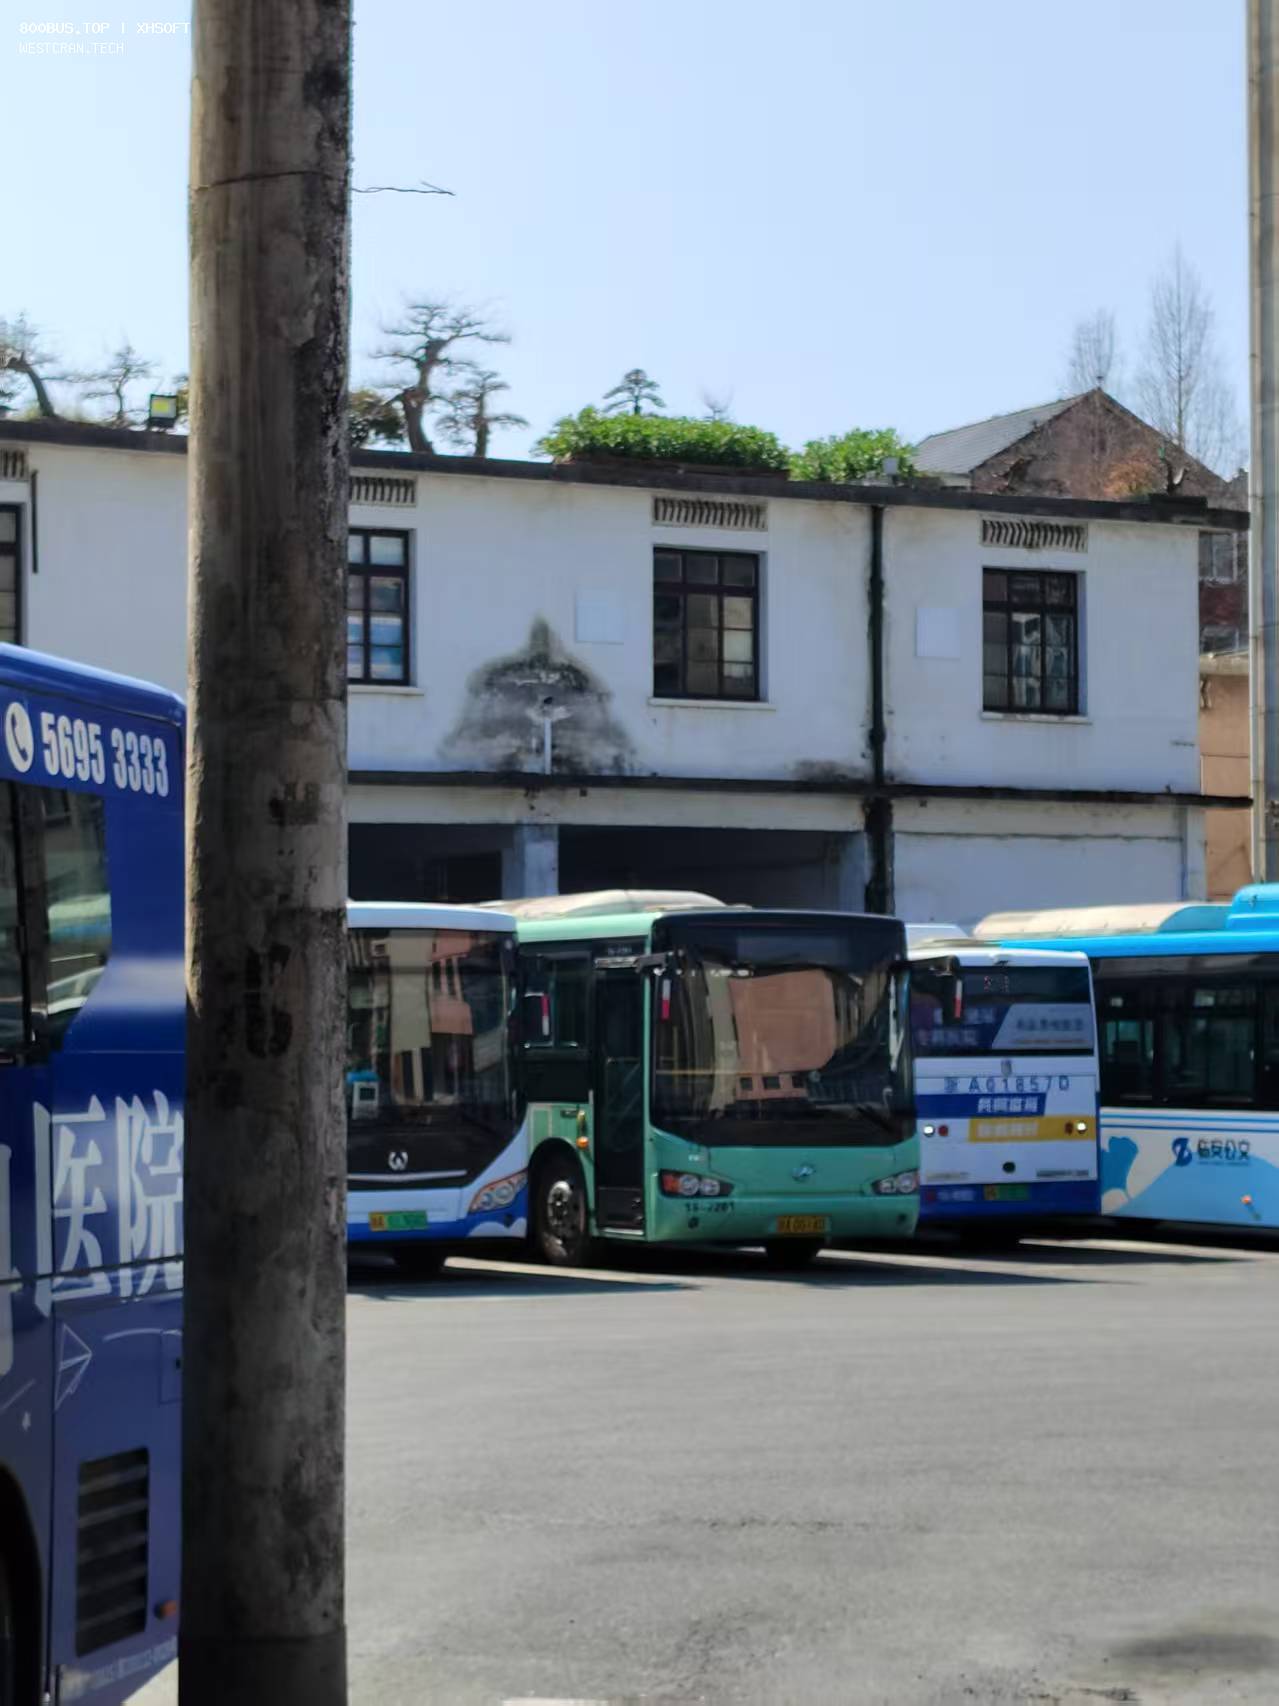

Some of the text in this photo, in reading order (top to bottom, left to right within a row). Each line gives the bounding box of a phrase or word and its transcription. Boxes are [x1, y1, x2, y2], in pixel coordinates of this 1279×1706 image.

[40, 711, 169, 798] 5695 3333
[0, 1089, 184, 1375] 医院
